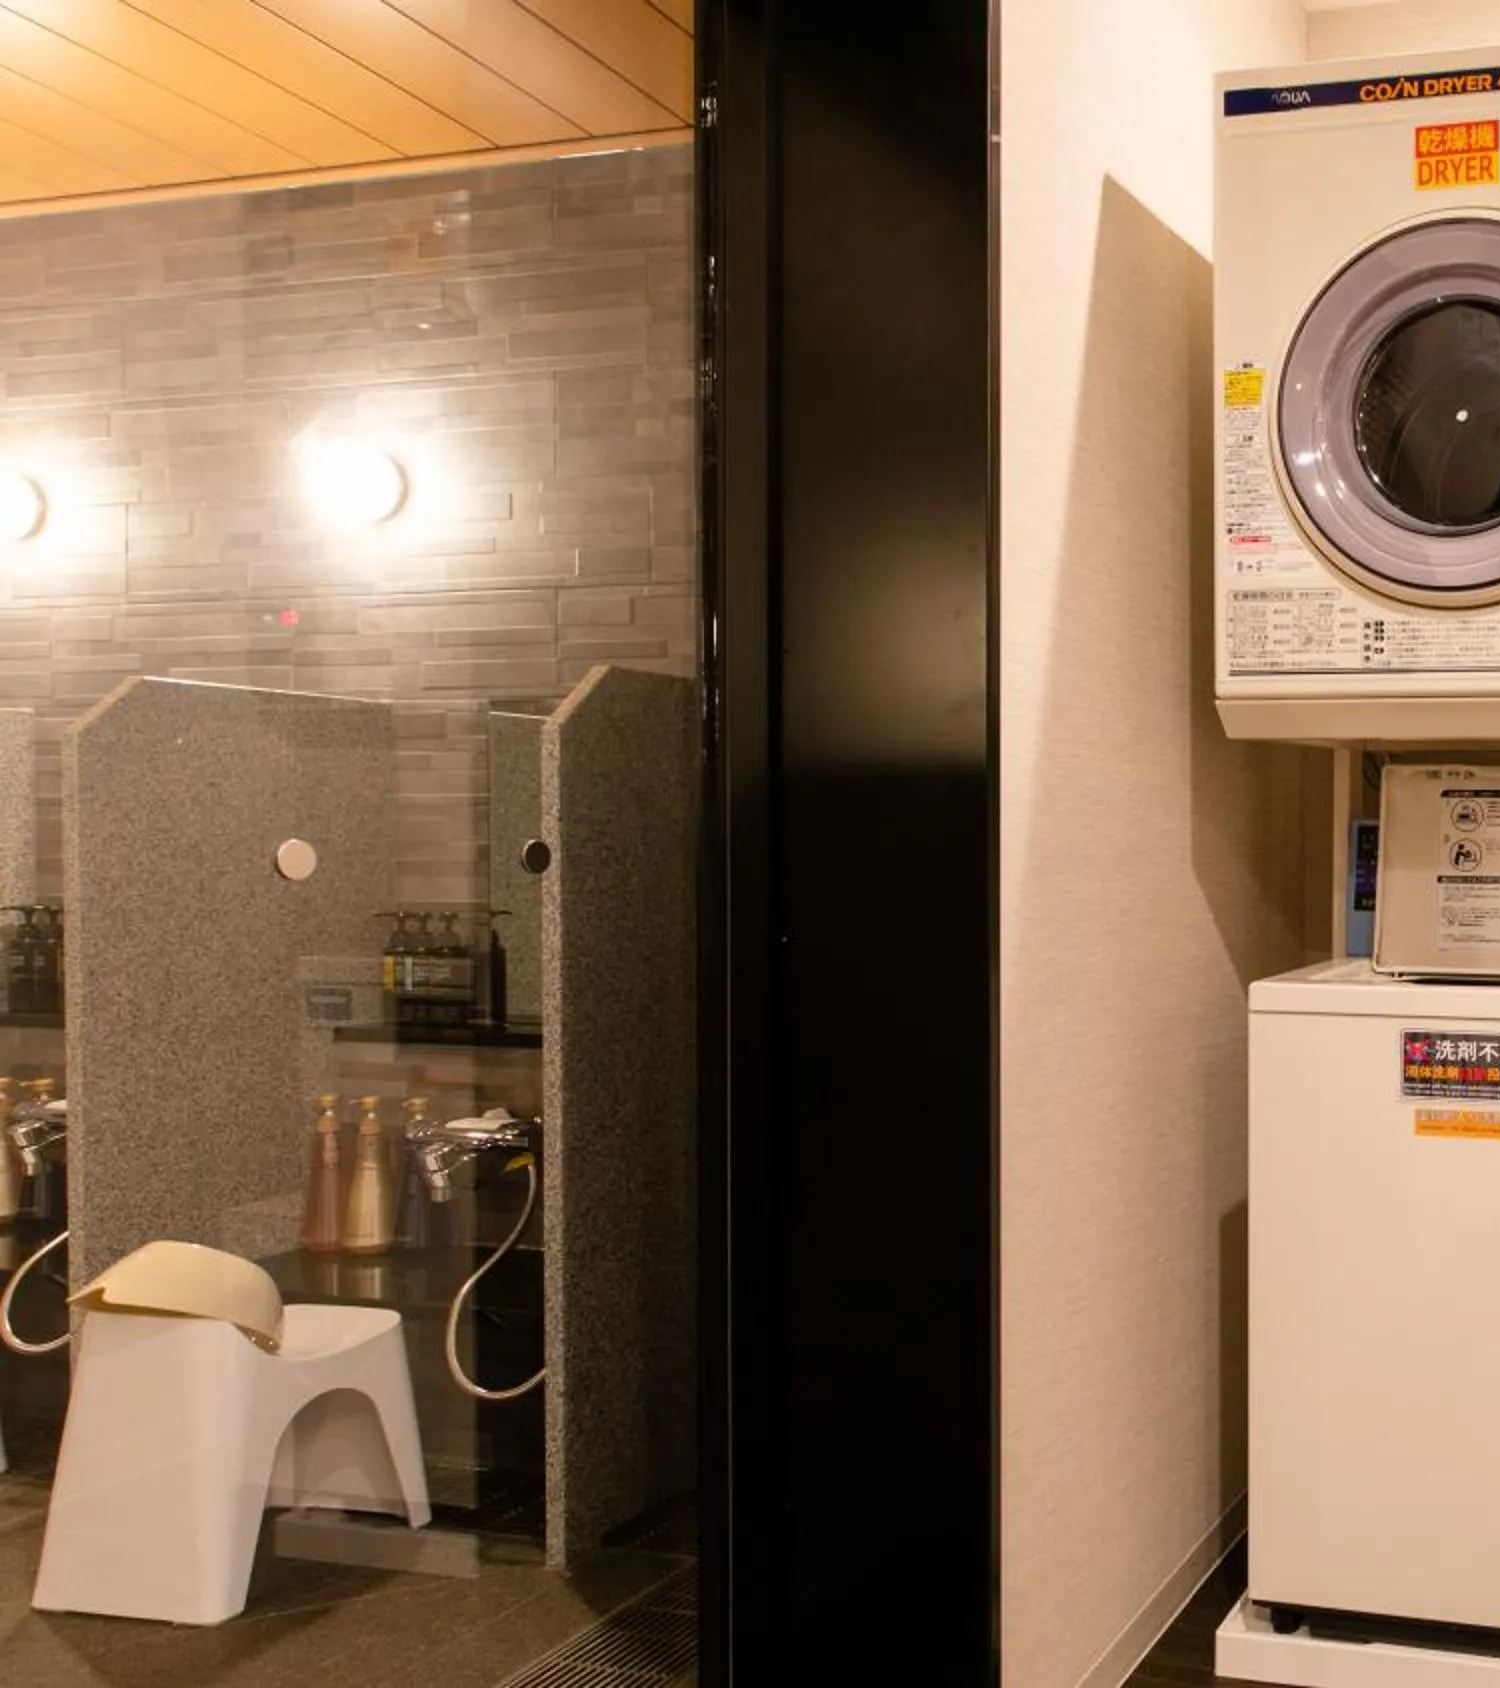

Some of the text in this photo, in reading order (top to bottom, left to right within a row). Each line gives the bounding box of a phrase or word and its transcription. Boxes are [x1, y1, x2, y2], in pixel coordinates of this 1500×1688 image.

[1424, 74, 1493, 97] DRYER
[1419, 123, 1496, 155] 乾燥機
[1418, 155, 1495, 187] DRYER
